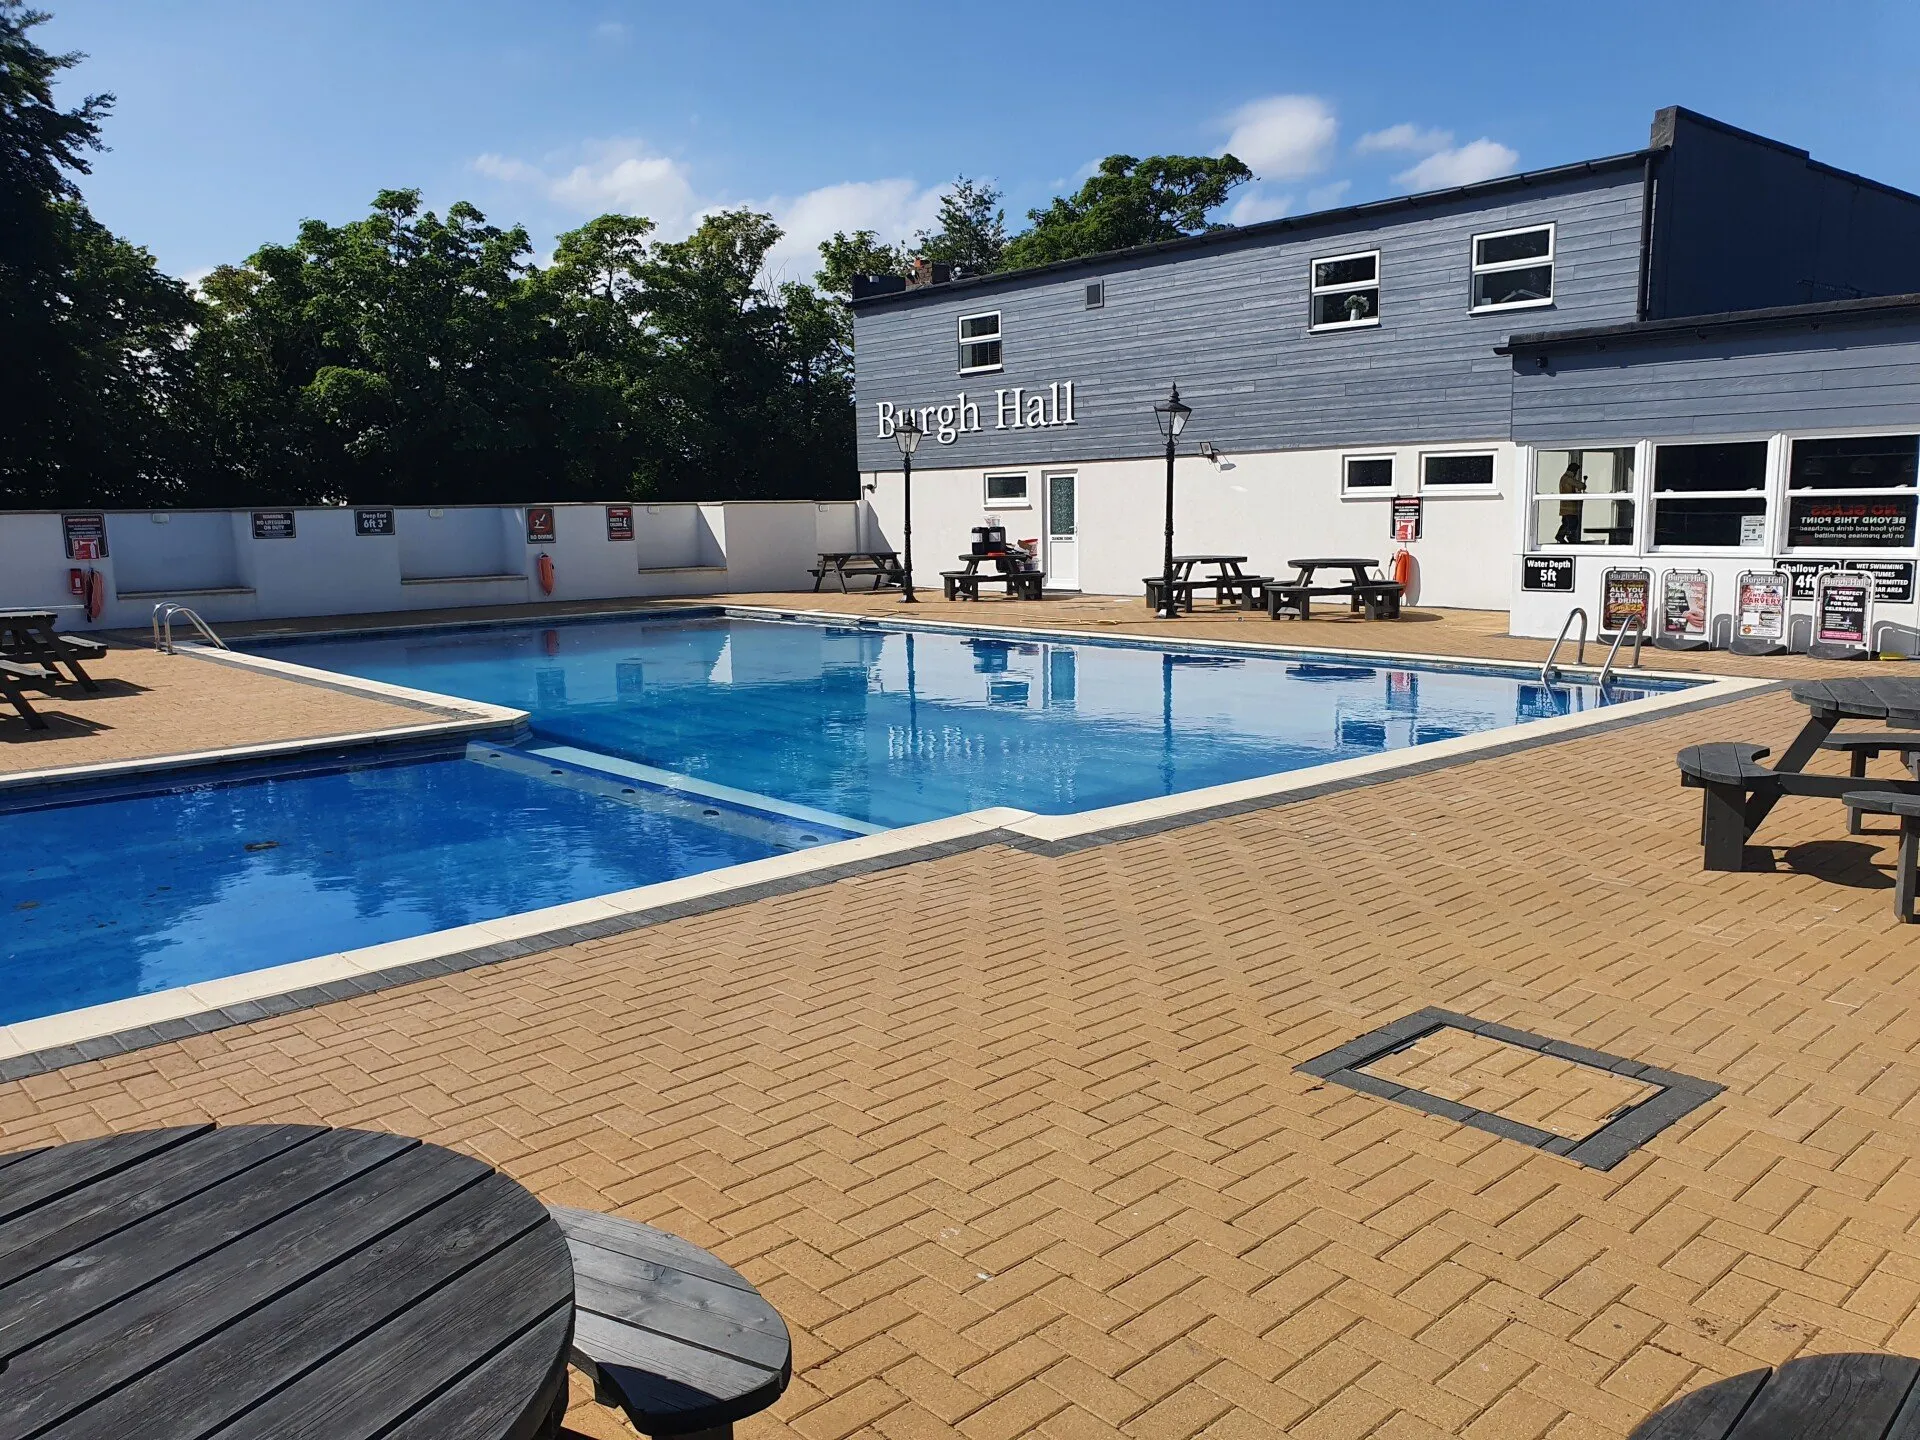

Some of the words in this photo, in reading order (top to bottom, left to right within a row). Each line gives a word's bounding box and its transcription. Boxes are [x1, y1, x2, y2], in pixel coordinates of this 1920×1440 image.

[875, 391, 984, 444] Burgh
[994, 380, 1077, 430] Hall
[362, 512, 377, 520] Deep
[363, 519, 377, 528] 6ft
[1527, 560, 1548, 568] Water
[1549, 560, 1571, 570] Depth
[1780, 564, 1816, 573] Shallow
[1540, 569, 1557, 581] 5ft
[1743, 575, 1766, 586] Burgh
[1767, 576, 1784, 584] Hall
[1875, 578, 1909, 586] PERMITTED
[1742, 596, 1782, 605] CARVERY
